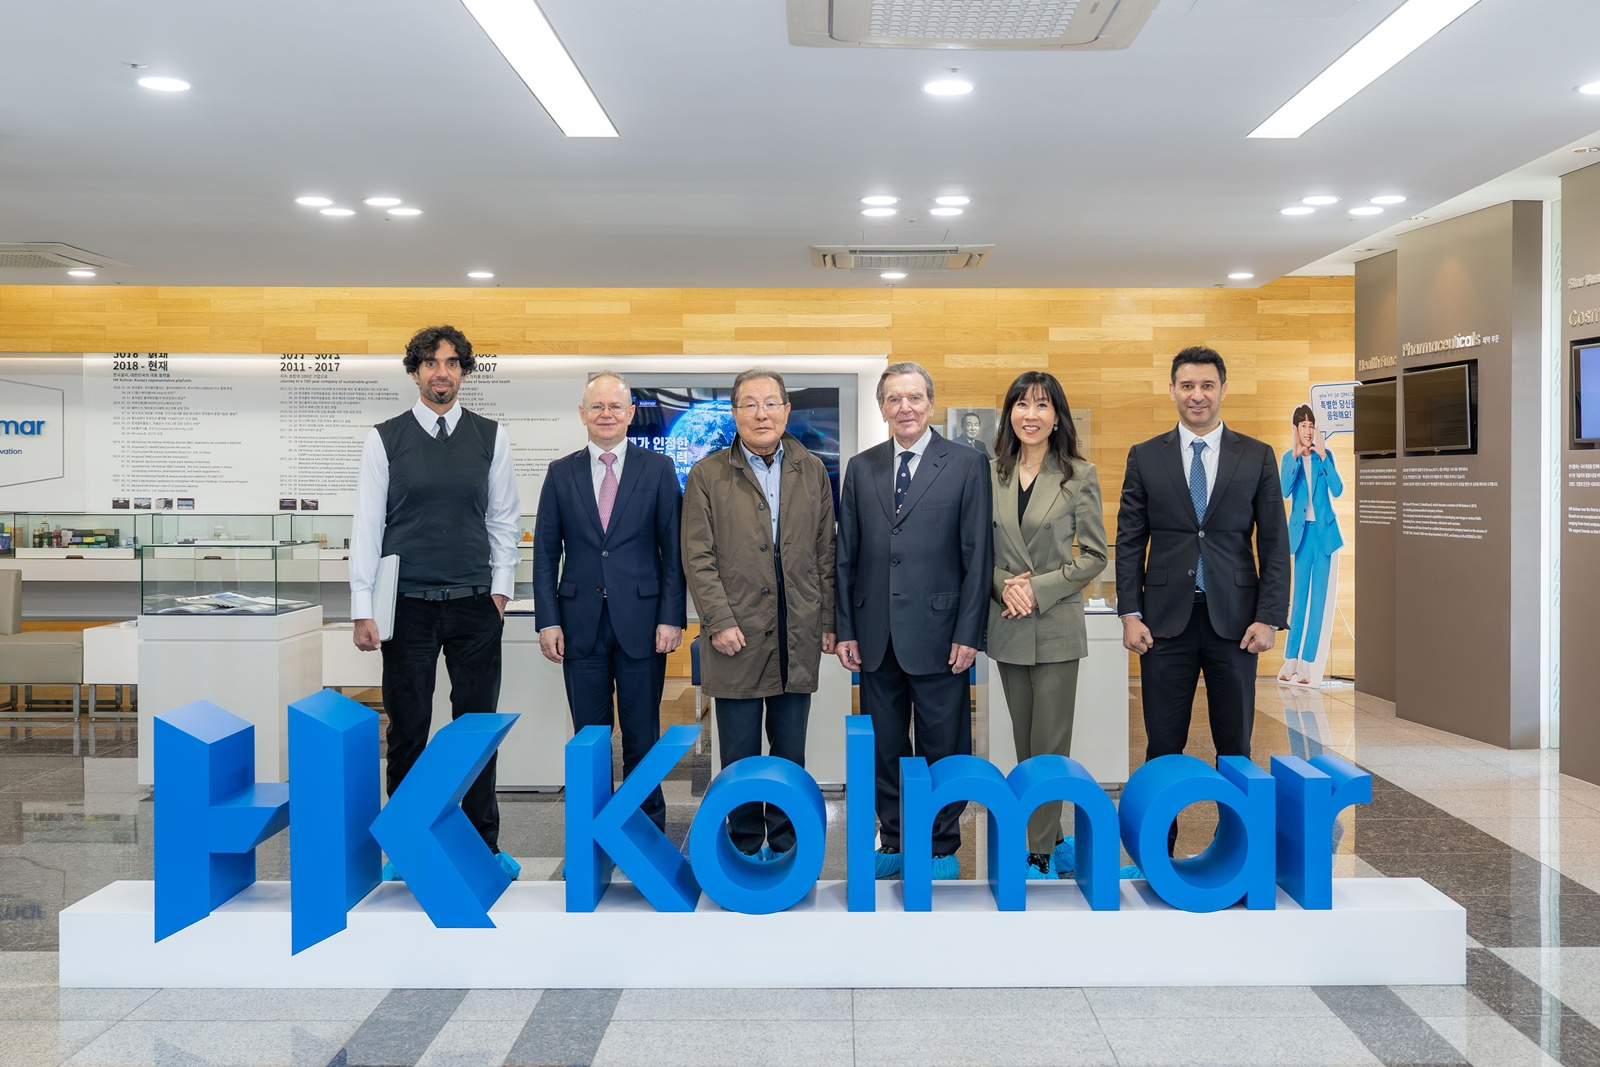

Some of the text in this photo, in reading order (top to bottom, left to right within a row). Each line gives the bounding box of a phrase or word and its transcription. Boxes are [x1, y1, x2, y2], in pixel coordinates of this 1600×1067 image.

[1402, 331, 1481, 357] Pharmaceuticals
[112, 360, 138, 370] 2018
[148, 360, 168, 372] 현재
[280, 362, 306, 372] 2011
[314, 362, 340, 372] 2017
[1358, 356, 1381, 372] Health
[1320, 400, 1338, 410] 특별한
[1327, 410, 1352, 420] 응원해요!
[652, 436, 688, 450] 인정한
[154, 688, 1372, 956] HK Kolmar
